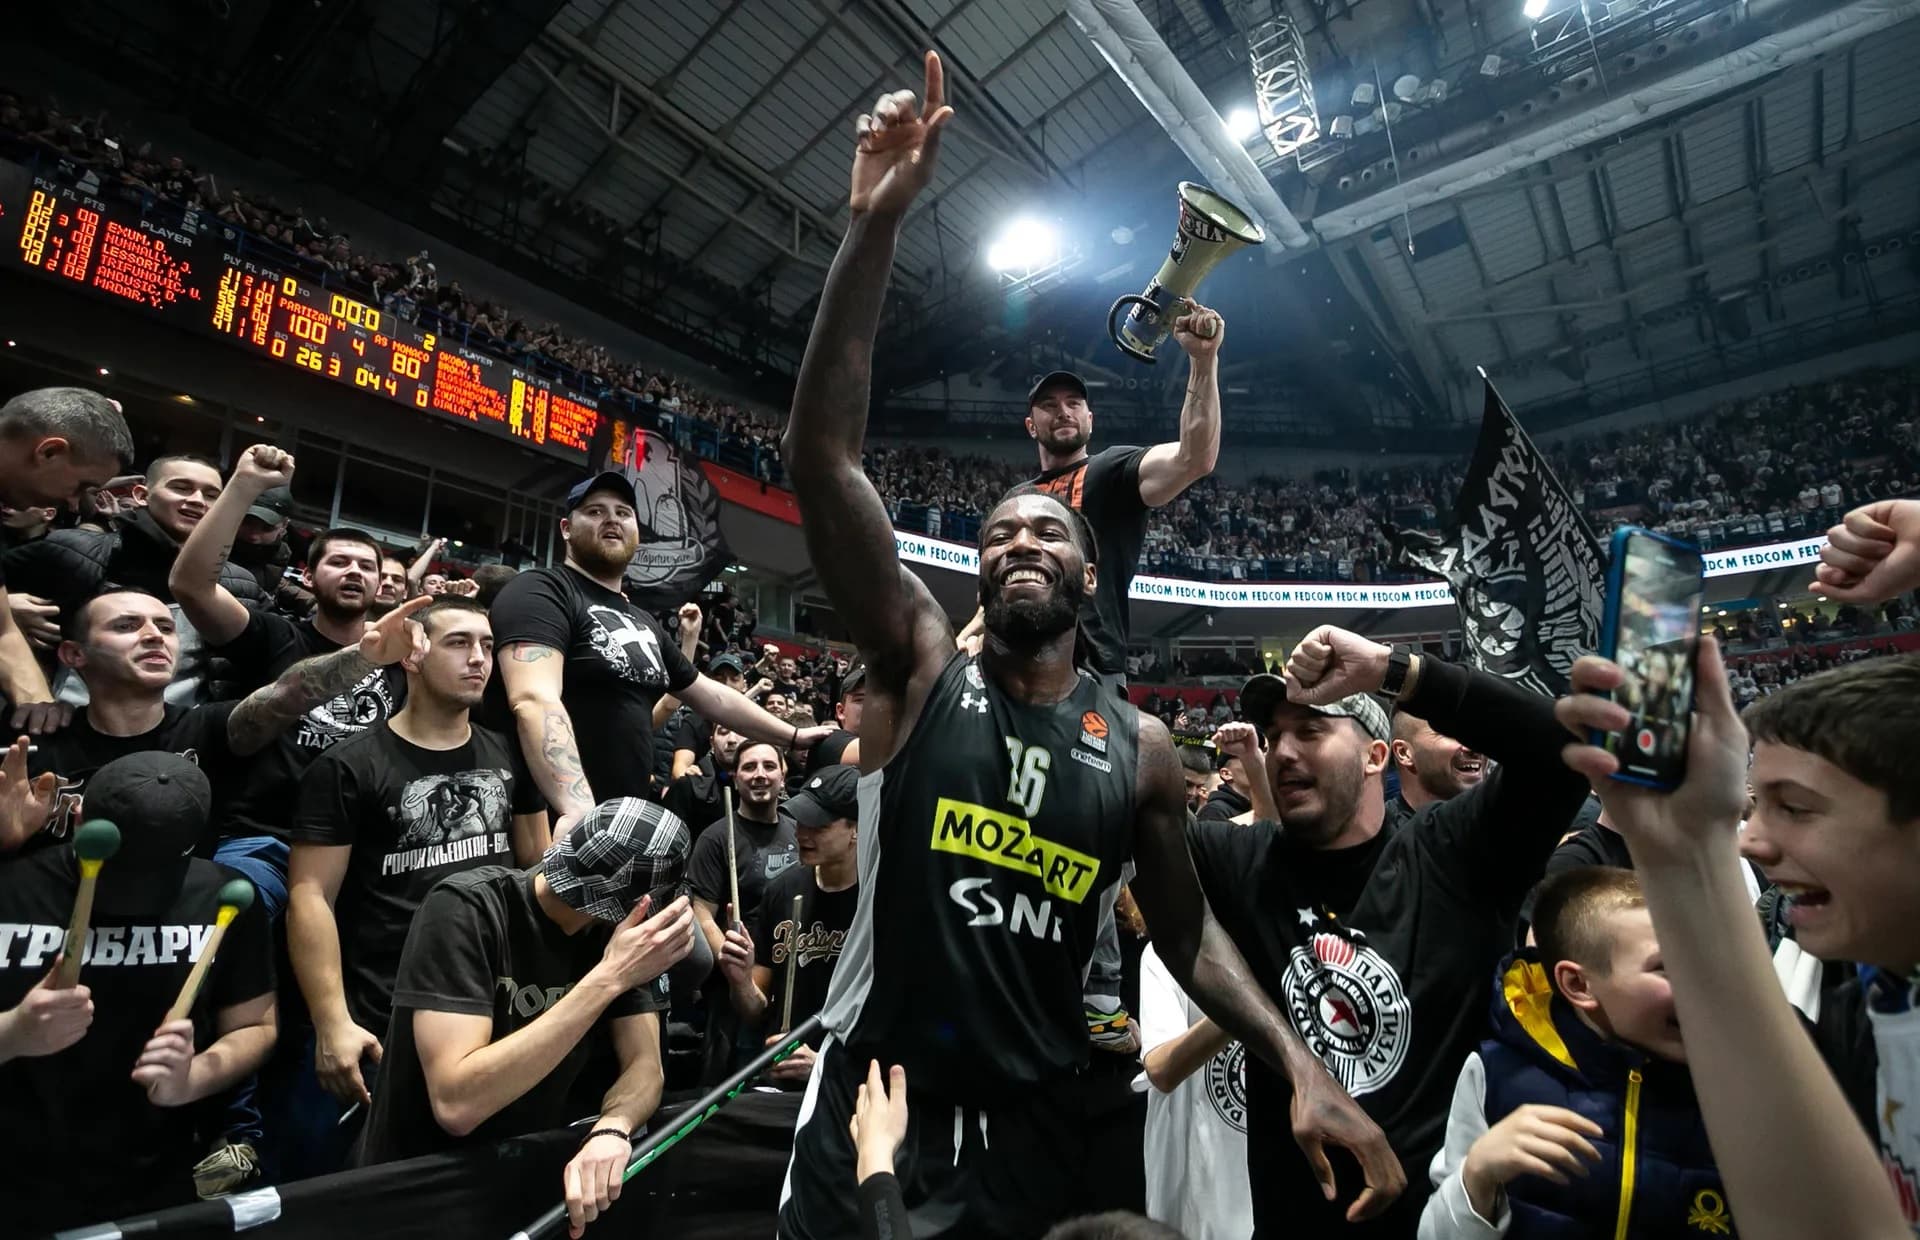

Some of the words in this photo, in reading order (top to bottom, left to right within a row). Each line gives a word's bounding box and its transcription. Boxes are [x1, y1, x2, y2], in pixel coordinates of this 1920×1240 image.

[33, 190, 56, 208] 01
[34, 177, 56, 191] PLY
[62, 188, 78, 201] FL
[83, 196, 106, 211] PTS
[58, 214, 69, 227] 3
[52, 236, 63, 248] 4
[107, 221, 151, 246] EXUM,
[140, 220, 192, 247] PLAYER
[24, 250, 41, 265] 10
[46, 258, 57, 271] 2
[102, 243, 164, 274] LESSORT,
[224, 253, 241, 266] PLY
[245, 262, 257, 273] FL
[261, 269, 280, 281] PTS
[94, 275, 146, 302] MADAR,
[97, 266, 161, 296] ANDUSIC,
[283, 277, 297, 296] 0
[298, 287, 310, 297] TO
[280, 297, 332, 326] PARTIZAN
[337, 319, 347, 331] M
[290, 313, 327, 345] 100
[413, 333, 424, 342] TO
[271, 338, 286, 357] 0
[353, 338, 365, 357] 4
[392, 340, 429, 363] MONACO
[423, 333, 436, 352] 2
[296, 346, 322, 370] 26
[328, 357, 341, 377] 3
[392, 352, 421, 379] 80
[459, 347, 493, 367] PLAYER
[355, 367, 380, 390] 04
[512, 368, 524, 378] PLY
[385, 378, 397, 396] 4
[416, 389, 428, 407] 0
[568, 391, 597, 408] PLAYER
[896, 539, 926, 557] DCOM
[930, 546, 970, 567] FEDCOM
[1742, 548, 1794, 566] FEDCOM
[1798, 543, 1824, 559] FED
[1135, 582, 1173, 596] FEDCOM
[1210, 590, 1248, 601] FEDCOM
[1252, 591, 1291, 601] FEDCOM
[1295, 591, 1333, 601] FEDCOM
[1373, 591, 1411, 601] FEDCOM
[768, 853, 790, 868] NIKE
[1356, 959, 1399, 1078] ПАРТИЗАН
